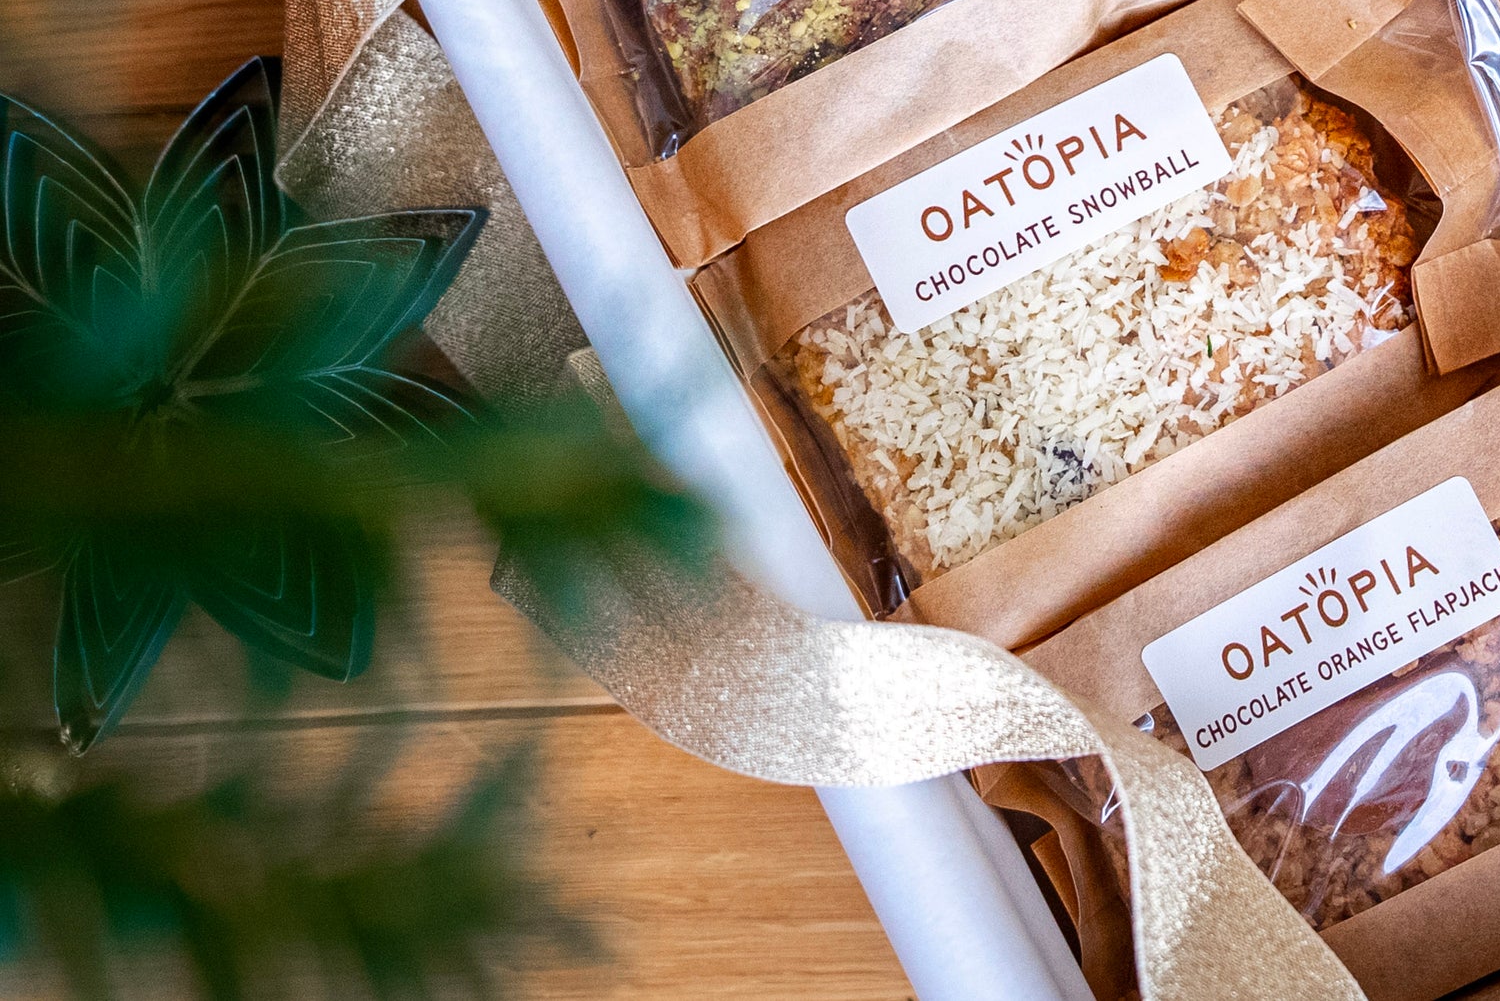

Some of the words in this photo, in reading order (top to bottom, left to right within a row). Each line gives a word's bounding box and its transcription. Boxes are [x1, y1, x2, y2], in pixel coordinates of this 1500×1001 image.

[915, 215, 1061, 302] CHOCOLATE
[1067, 148, 1200, 225] SNOWBALL
[920, 113, 1148, 243] OATOPIA
[1220, 545, 1440, 681] OATOPIA
[1195, 671, 1313, 749] CHOCOLATE
[1317, 623, 1404, 681] ORANGE
